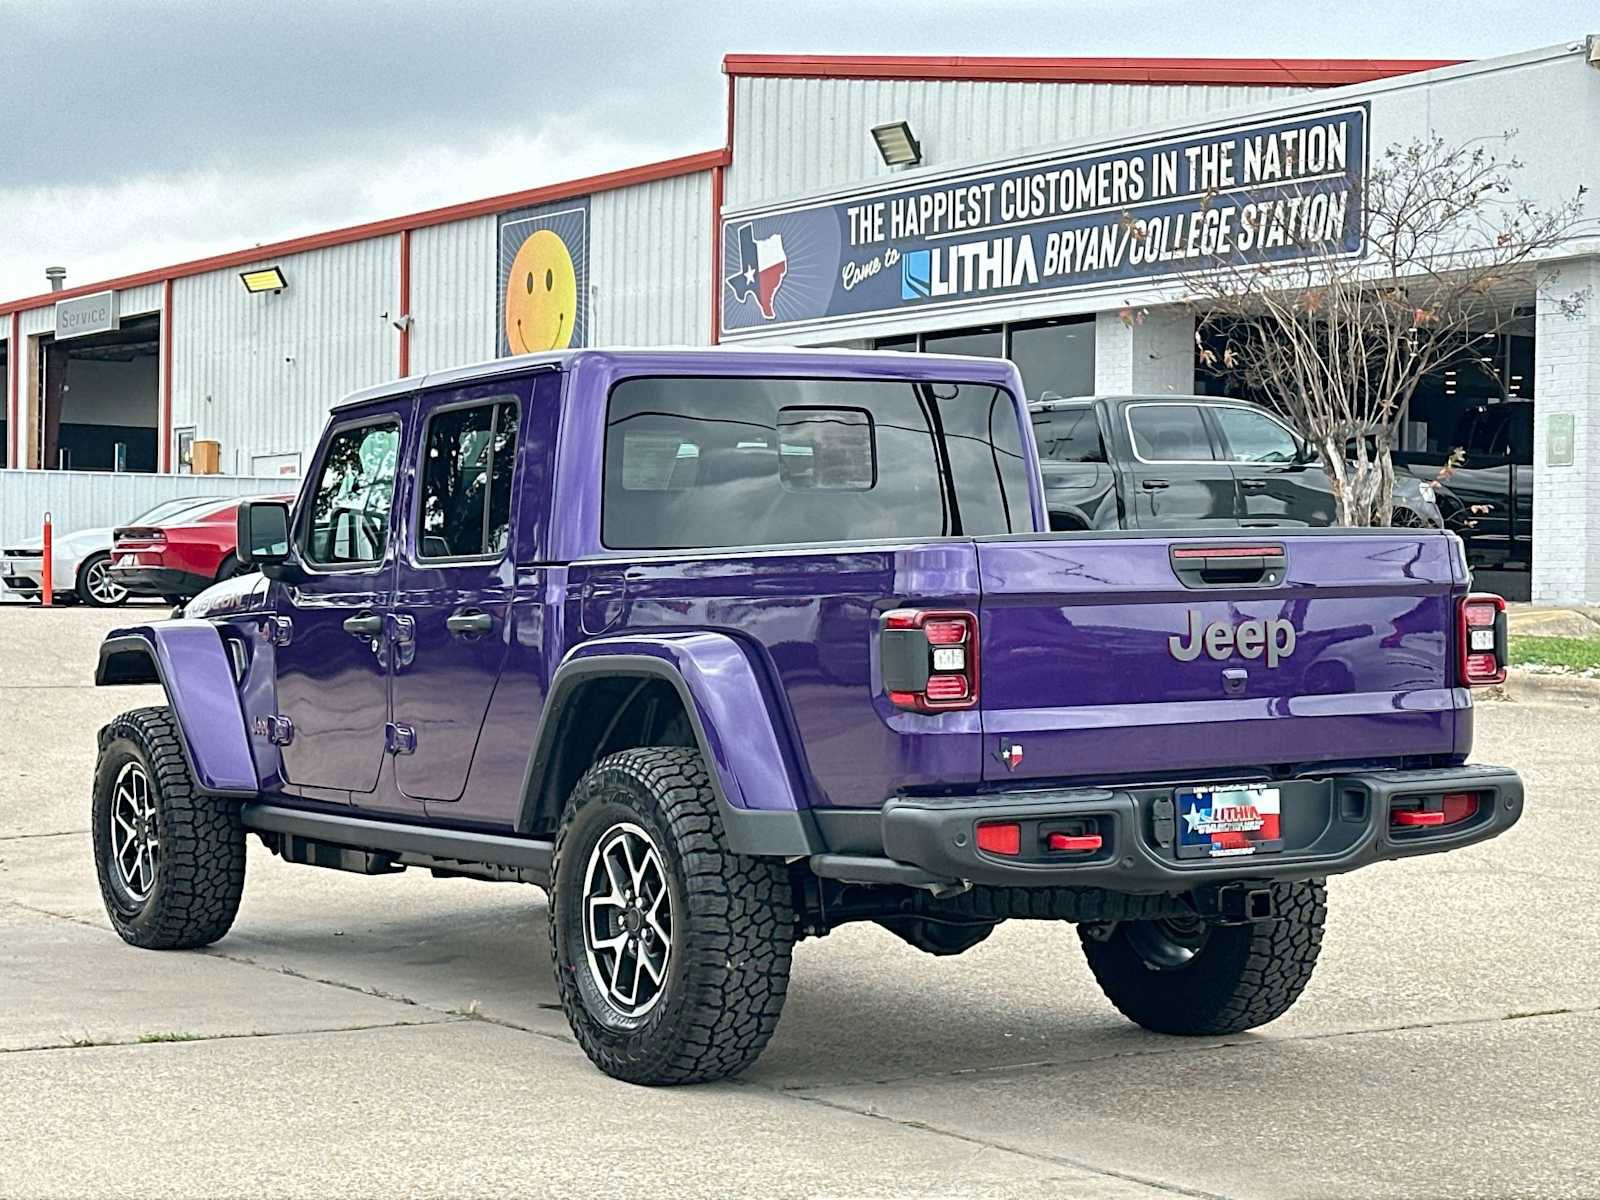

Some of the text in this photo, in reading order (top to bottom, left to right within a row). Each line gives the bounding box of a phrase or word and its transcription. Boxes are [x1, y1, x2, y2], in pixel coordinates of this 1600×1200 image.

[847, 121, 1348, 246] THE HAPPIEST CUSTOMERS IN THE NATION
[842, 190, 1349, 297] Come to LITHIA BRYAN/COLLEGE STATION
[61, 307, 106, 329] Service
[187, 592, 242, 613] UBICON
[1168, 609, 1296, 668] Jeep
[1213, 805, 1262, 823] LITHIA
